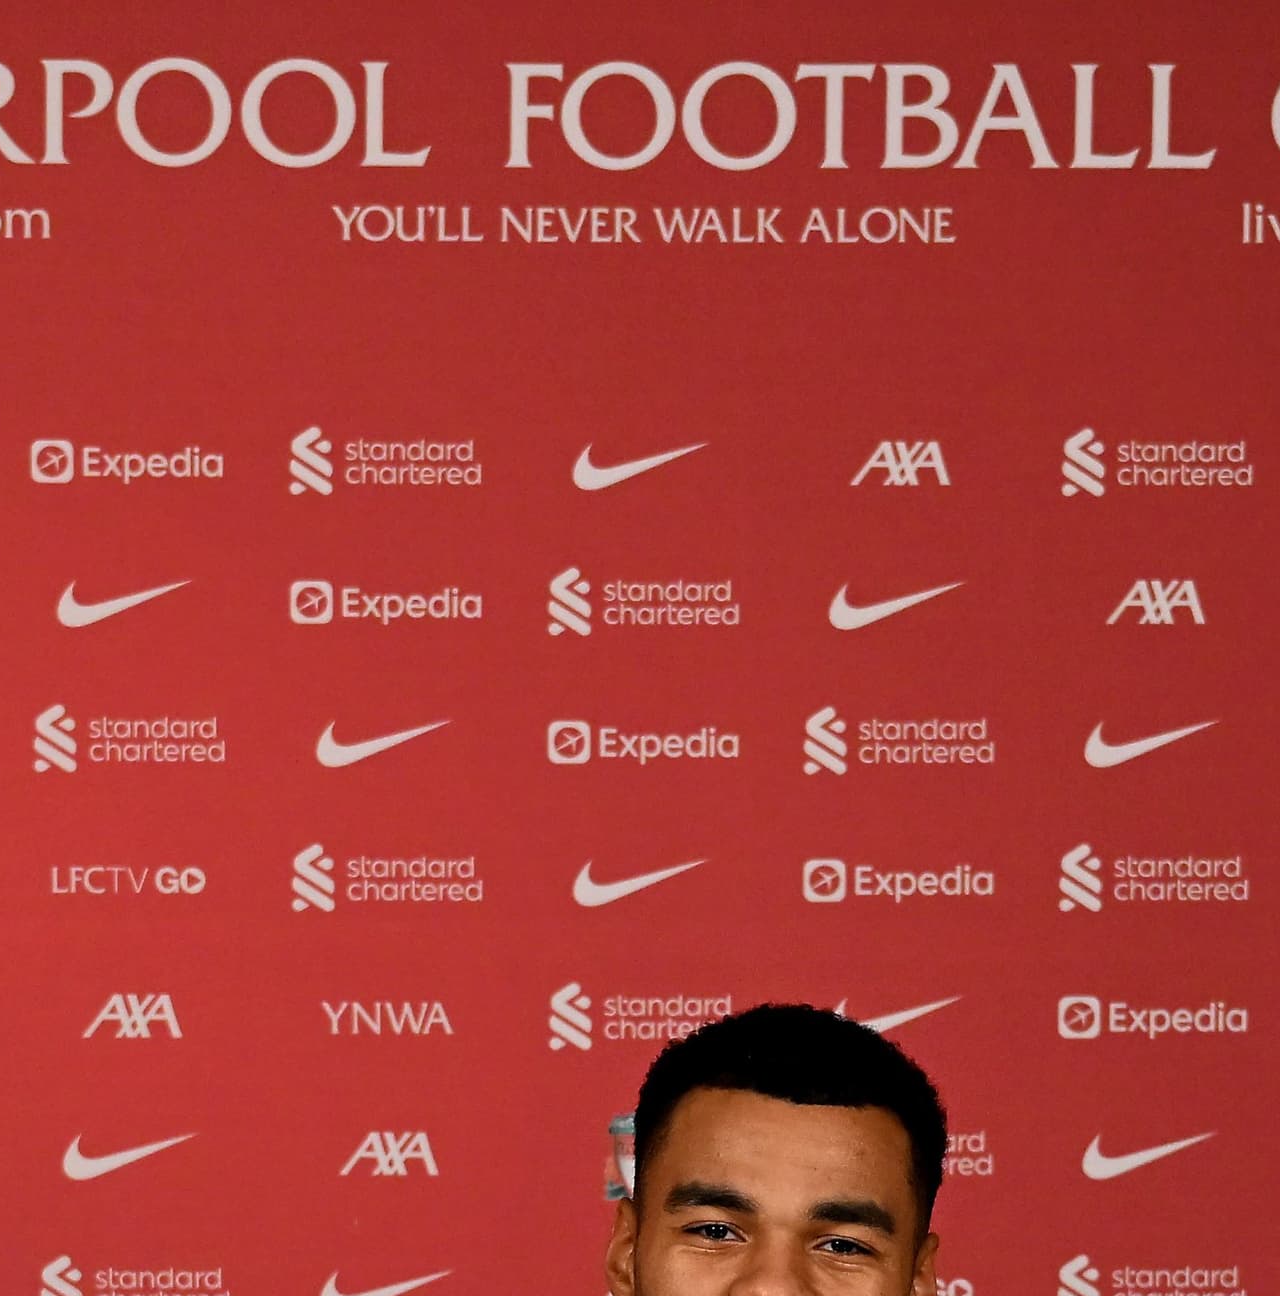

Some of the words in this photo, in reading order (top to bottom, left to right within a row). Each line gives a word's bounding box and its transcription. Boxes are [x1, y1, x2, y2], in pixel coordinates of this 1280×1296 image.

[505, 60, 1217, 171] FOOTBALL
[332, 205, 484, 242] YOU'LL
[501, 206, 641, 243] NEVER
[653, 207, 784, 243] WALK
[800, 206, 956, 243] ALONE
[82, 446, 223, 484] Expedia
[850, 440, 951, 486] AXA
[1118, 441, 1245, 463] standard
[1117, 464, 1253, 486] chartered
[341, 587, 482, 625] Expedia
[603, 580, 731, 602] standard
[1106, 579, 1205, 625] AXA
[603, 603, 740, 625] chartered
[90, 717, 217, 739] standard
[599, 727, 739, 765] Expedia
[89, 740, 225, 762] chartered
[347, 856, 474, 878] standard
[854, 864, 994, 903] Expedia
[347, 880, 483, 901] chartered
[83, 993, 182, 1038] AXA
[322, 1001, 453, 1035] YNWA
[604, 994, 732, 1016] standard
[1109, 1001, 1248, 1039] Expedia
[340, 1131, 438, 1176] AXA
[1112, 1267, 1238, 1288] standard
